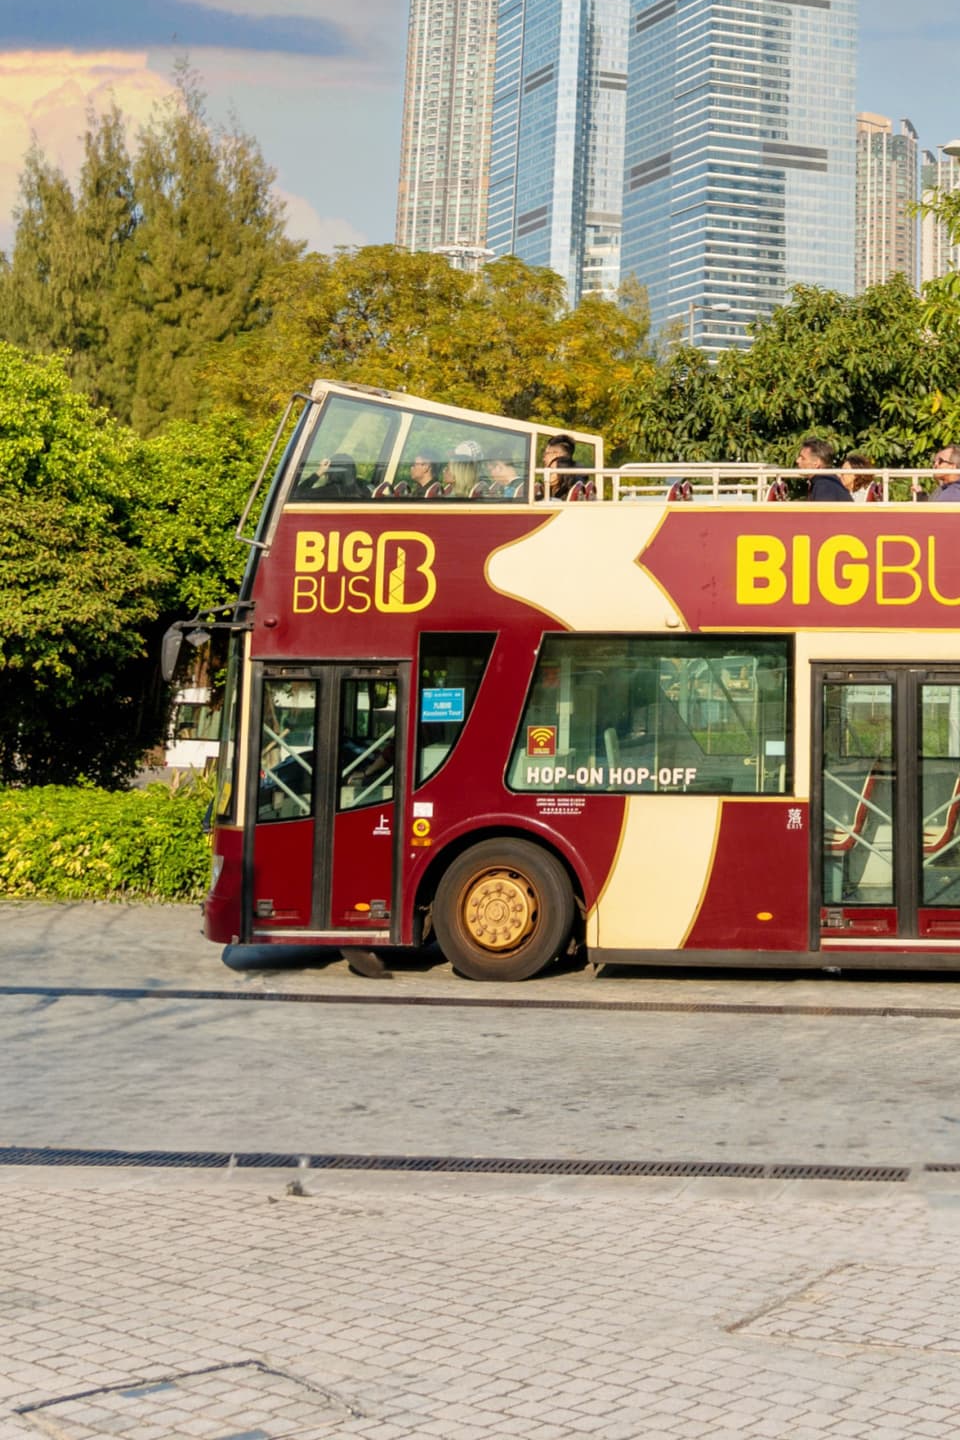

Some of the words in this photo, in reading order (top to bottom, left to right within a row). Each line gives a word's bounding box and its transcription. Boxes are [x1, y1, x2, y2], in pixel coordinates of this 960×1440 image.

[295, 531, 373, 572] BIG
[293, 575, 371, 613] BUS
[527, 767, 603, 784] HOP-ON
[609, 768, 697, 785] HOP-OFF
[374, 814, 389, 830] 上
